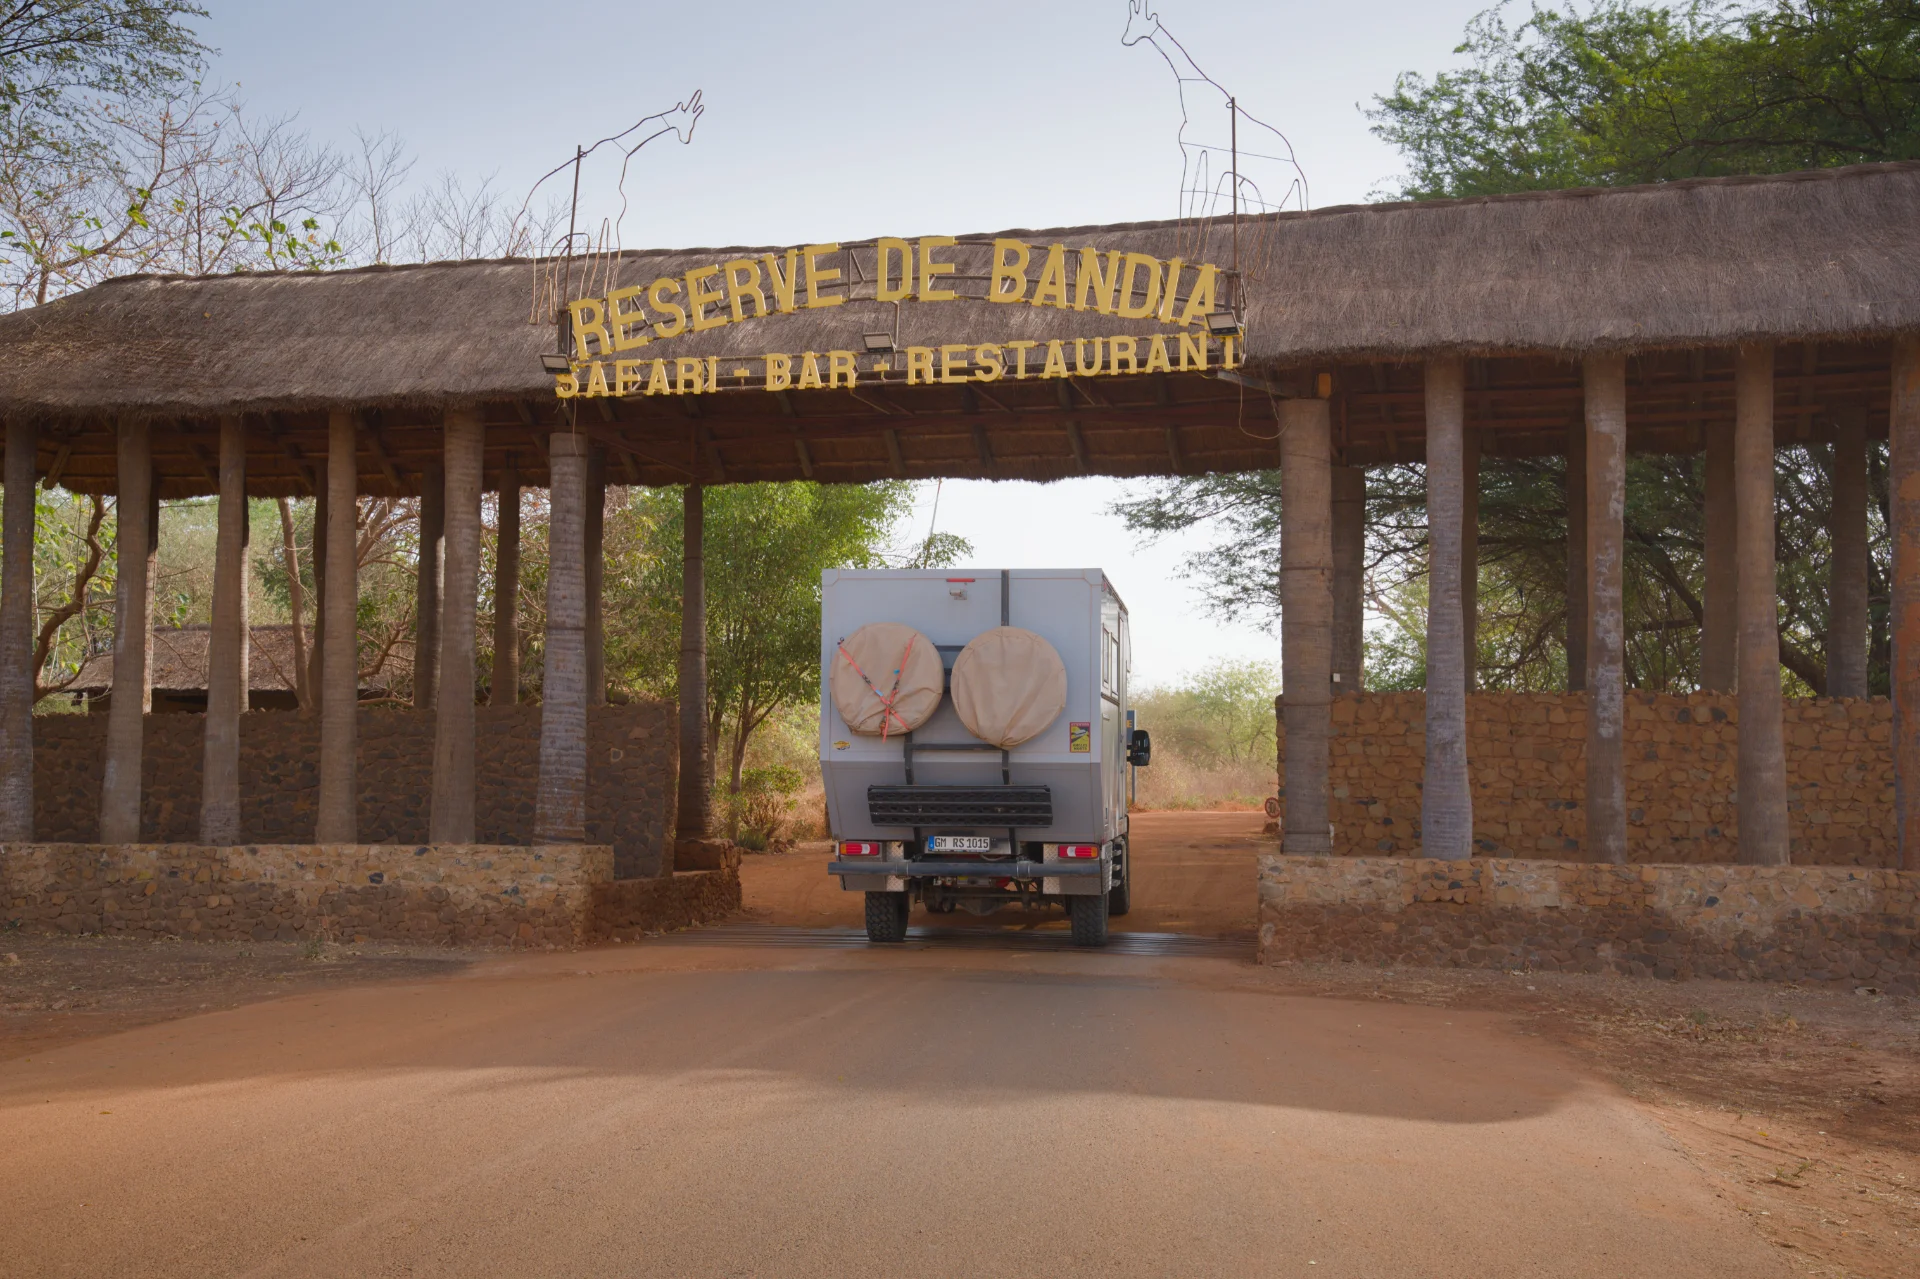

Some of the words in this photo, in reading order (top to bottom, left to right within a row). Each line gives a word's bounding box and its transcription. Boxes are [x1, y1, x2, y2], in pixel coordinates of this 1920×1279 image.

[570, 242, 844, 361] RESERVE
[876, 236, 956, 302] DE
[989, 238, 1216, 328] BANDIA
[555, 355, 717, 398] SAFARI
[766, 351, 856, 392] BAR
[934, 837, 947, 848] GM
[952, 837, 965, 848] RS
[966, 838, 989, 849] 1015
